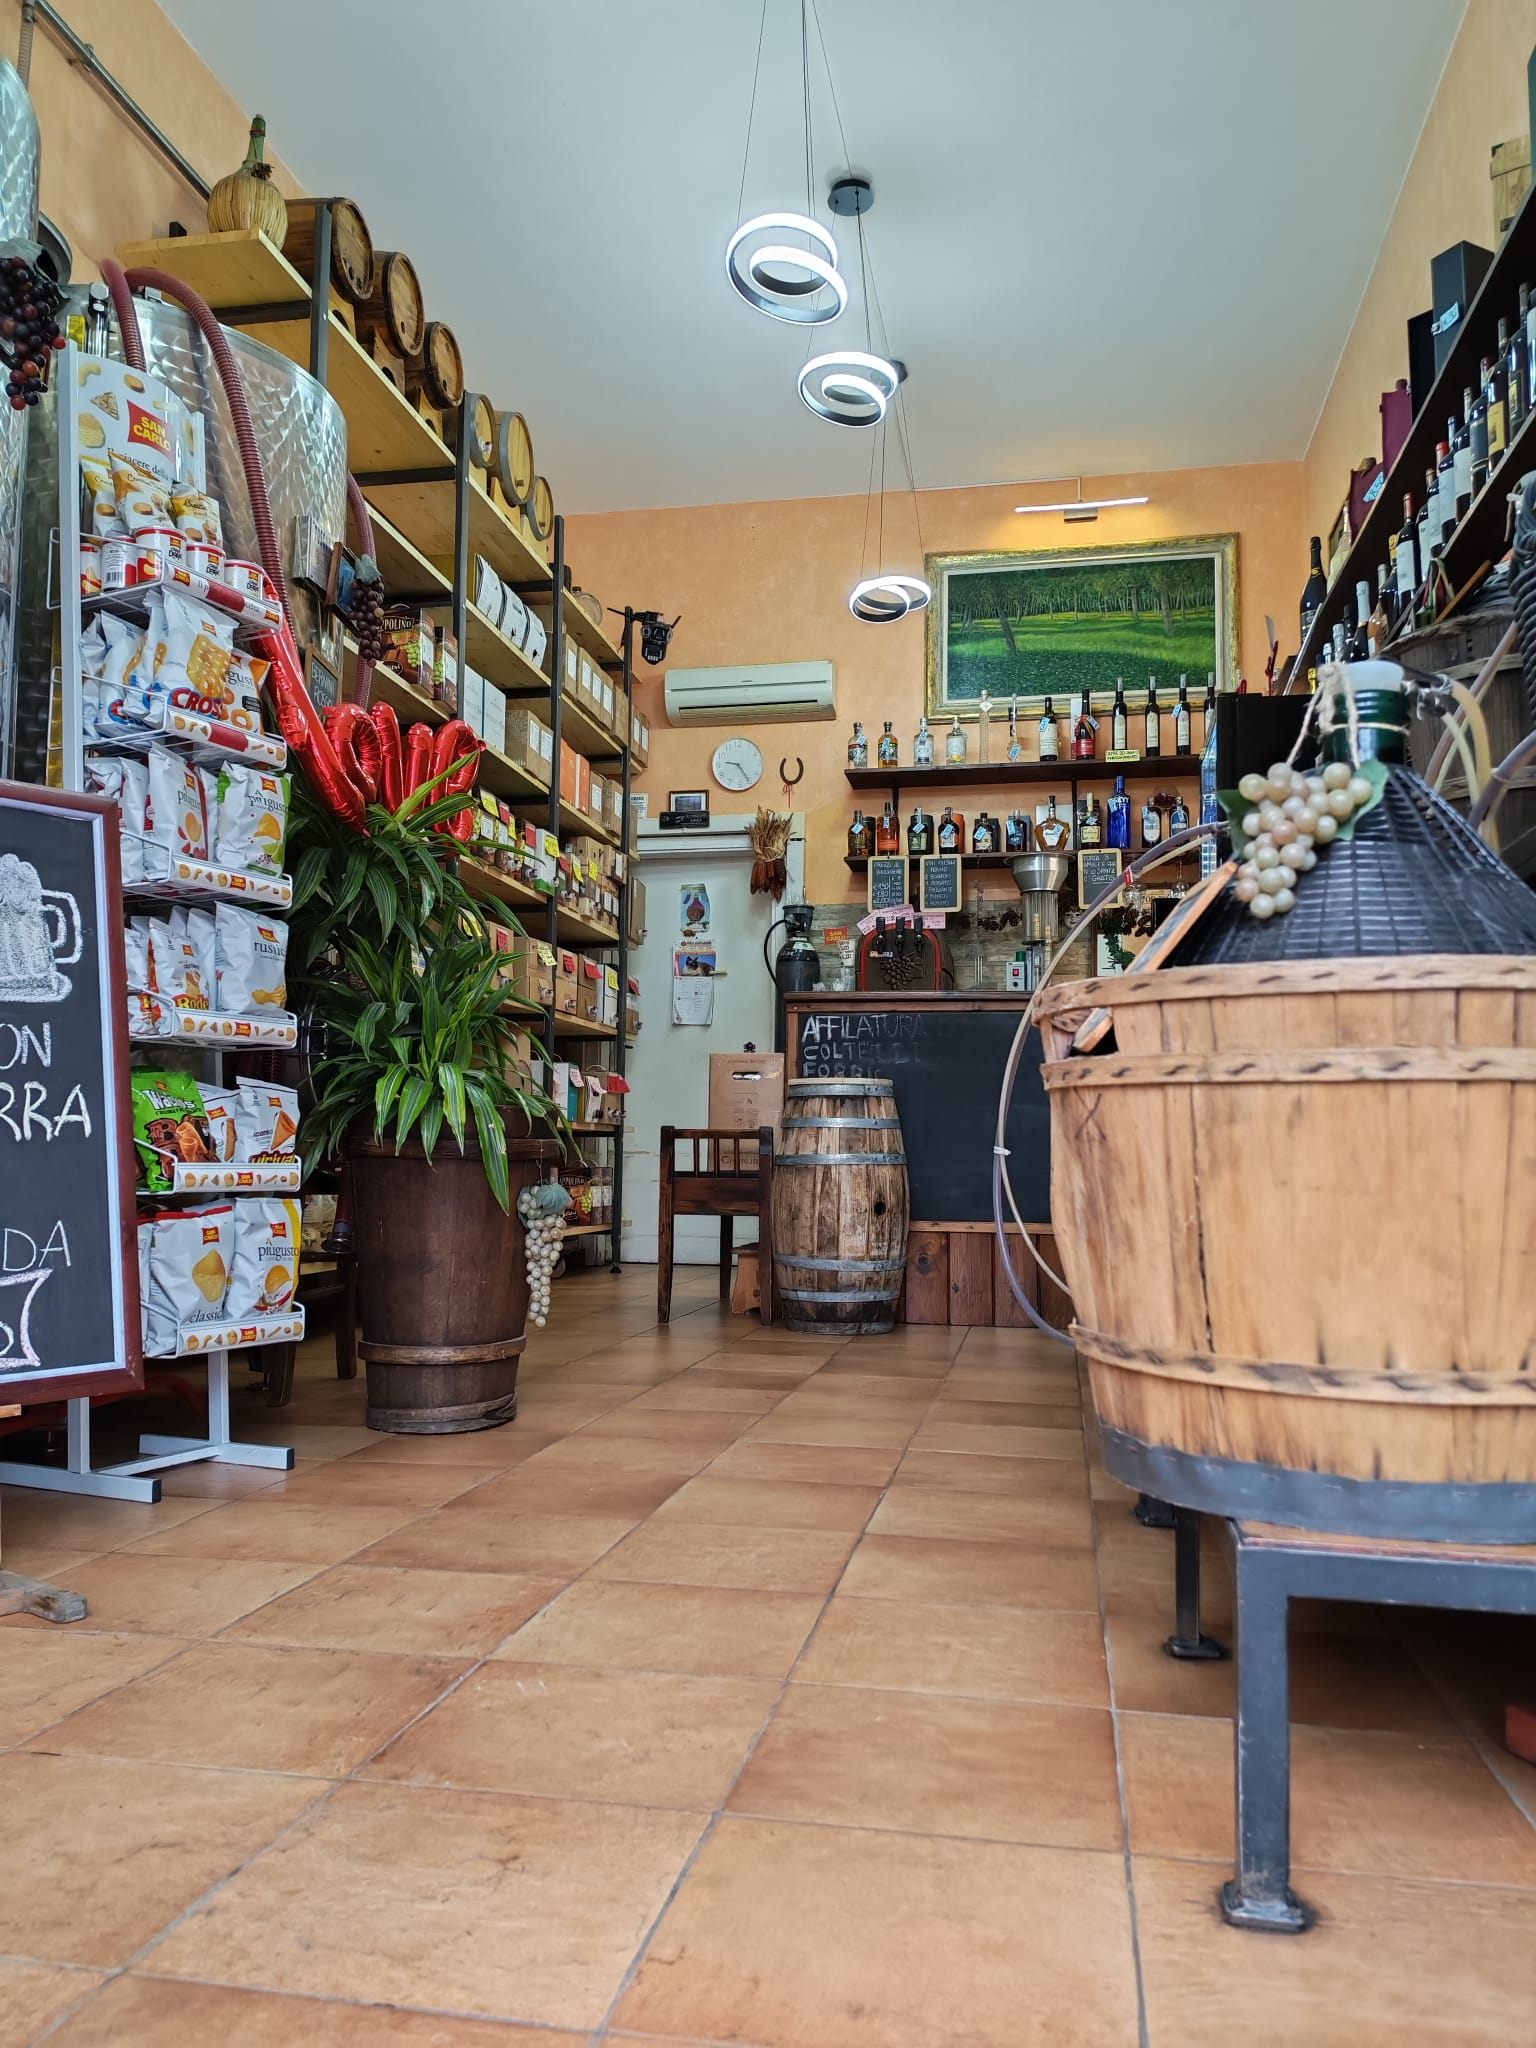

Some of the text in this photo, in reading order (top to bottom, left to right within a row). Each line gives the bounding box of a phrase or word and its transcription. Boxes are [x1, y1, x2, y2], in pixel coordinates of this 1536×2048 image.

[133, 424, 172, 453] CARLO
[140, 416, 166, 438] SAN
[826, 934, 847, 943] CARLO
[2, 1219, 72, 1271] DA
